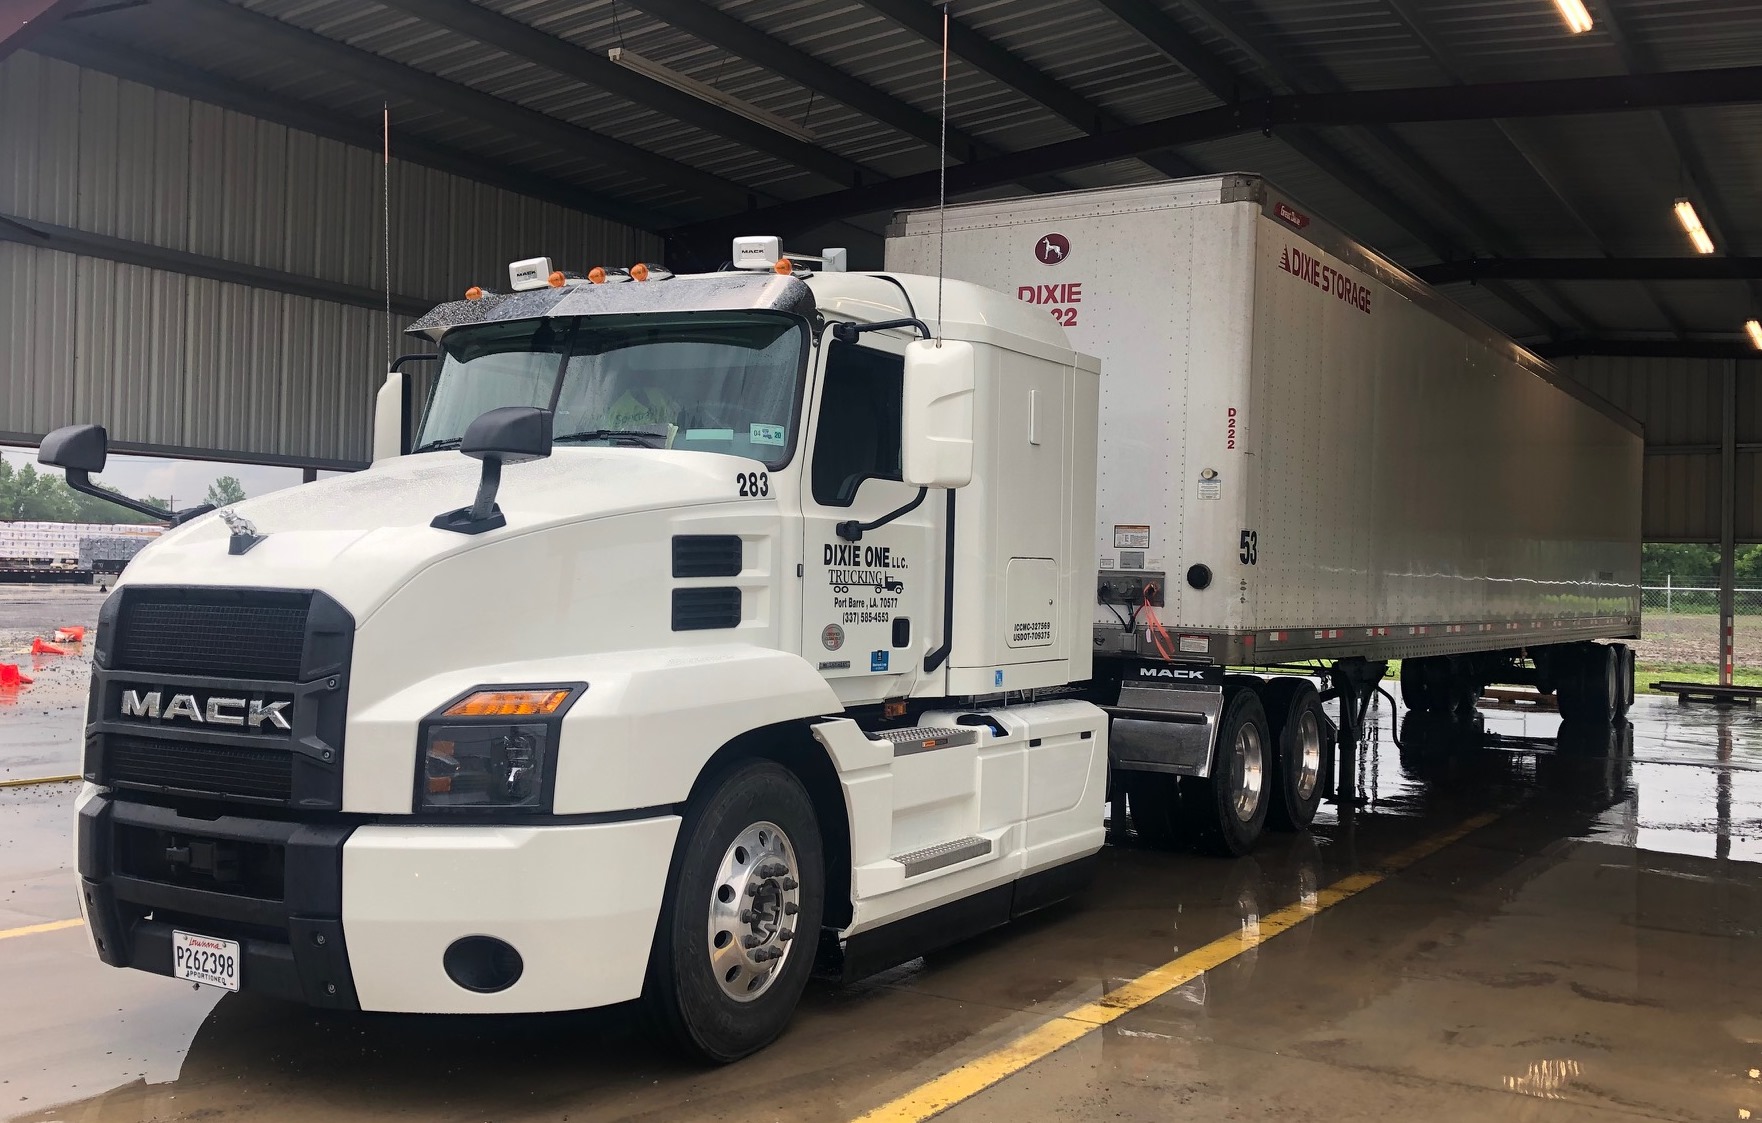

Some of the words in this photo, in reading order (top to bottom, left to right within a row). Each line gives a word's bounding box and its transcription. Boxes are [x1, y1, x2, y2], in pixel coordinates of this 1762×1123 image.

[1292, 247, 1321, 288] DIXIE
[1321, 264, 1371, 315] STORAGE
[1017, 282, 1083, 305] DIXIE
[1227, 407, 1237, 450] D222
[736, 472, 769, 497] 283
[823, 543, 861, 567] DIXIE
[864, 546, 890, 568] ONE
[1239, 530, 1258, 566] 53
[828, 569, 883, 585] TRUCKING
[834, 596, 847, 609] Port
[848, 596, 865, 609] Barre
[879, 597, 898, 609] 70577
[842, 611, 859, 625] (337)
[860, 612, 889, 624] 585-4553
[1013, 622, 1050, 631] ICCMC-327569
[1013, 631, 1050, 641] USDOT-709375
[1139, 667, 1205, 680] MACK
[121, 689, 292, 730] MACK
[176, 945, 234, 978] P262398
[186, 970, 226, 985] APPORTIONED
